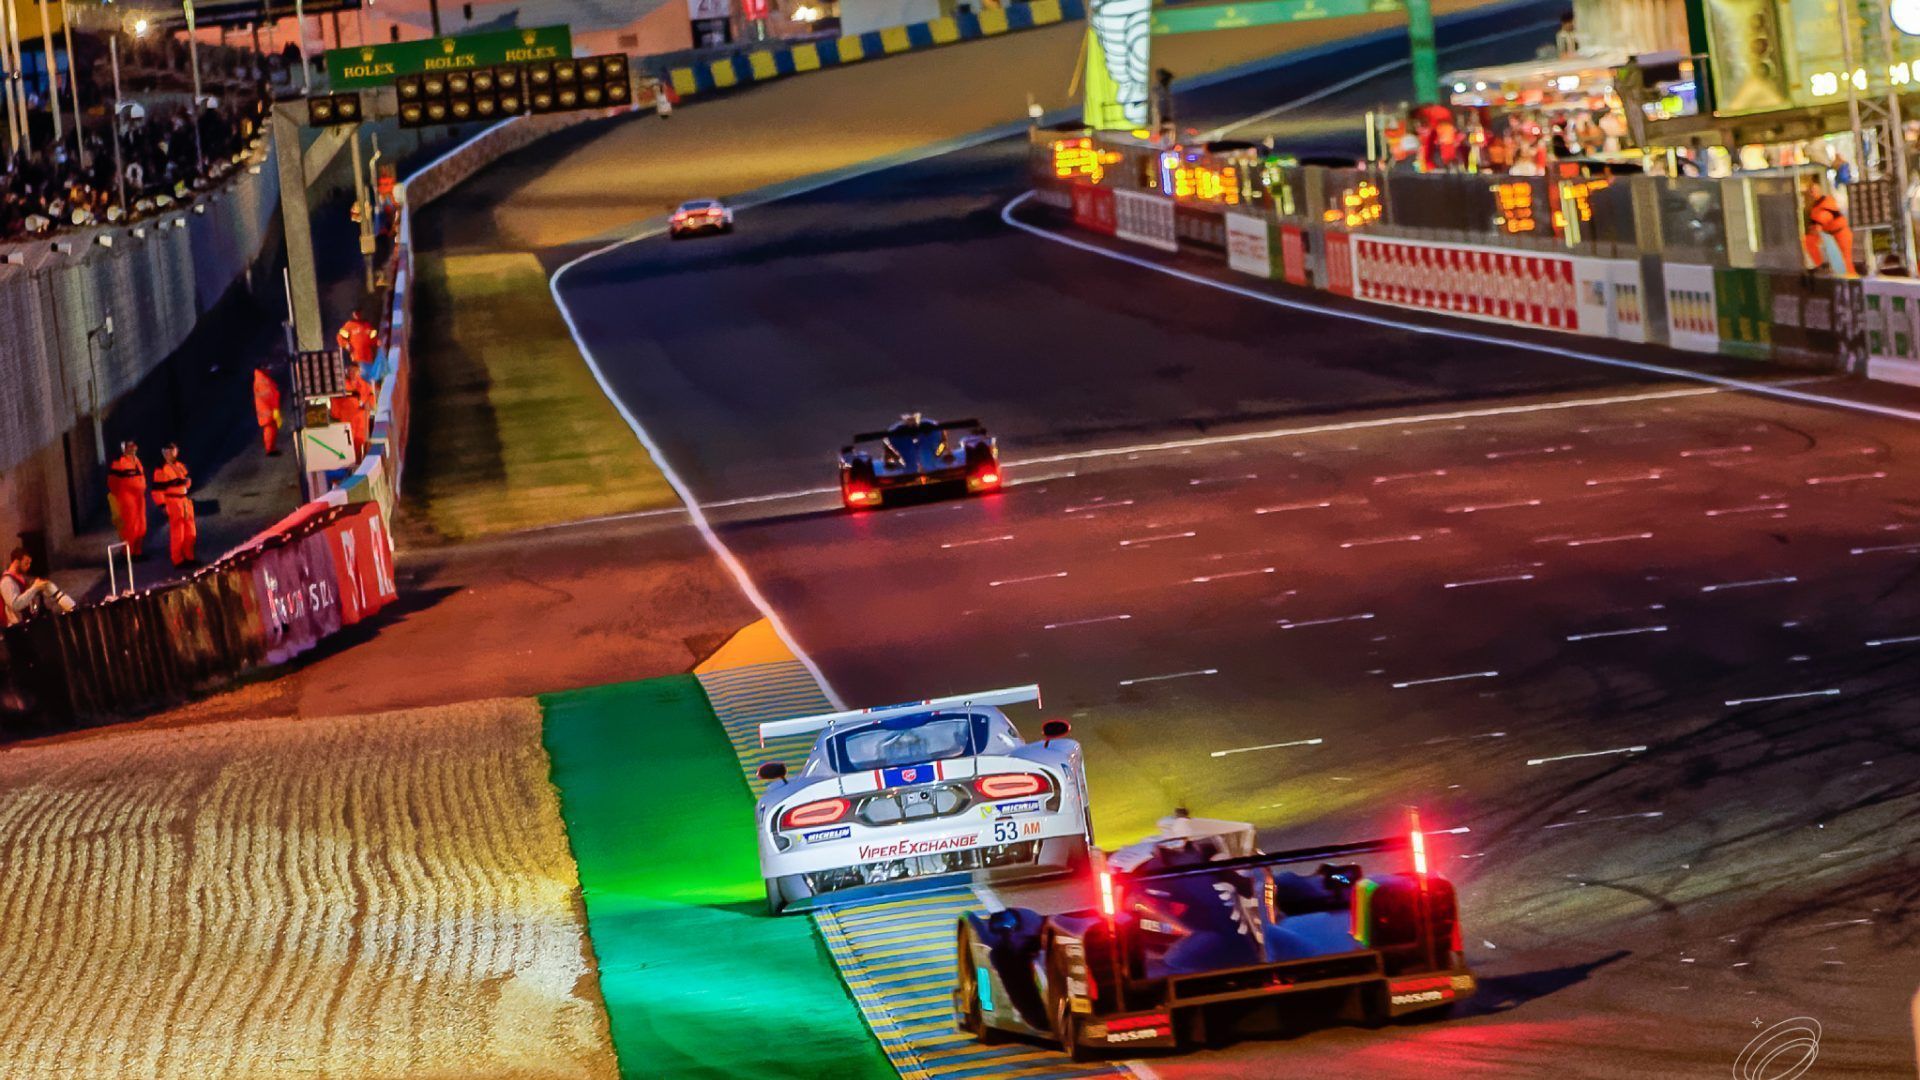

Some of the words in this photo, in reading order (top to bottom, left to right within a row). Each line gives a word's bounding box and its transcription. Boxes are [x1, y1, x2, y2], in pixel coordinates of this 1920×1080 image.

[424, 54, 476, 70] ROLEX
[505, 46, 557, 62] ROLEX
[343, 62, 395, 78] ROLEX
[807, 829, 850, 841] MICHELIN
[994, 821, 1018, 842] 53
[1023, 822, 1040, 836] AM
